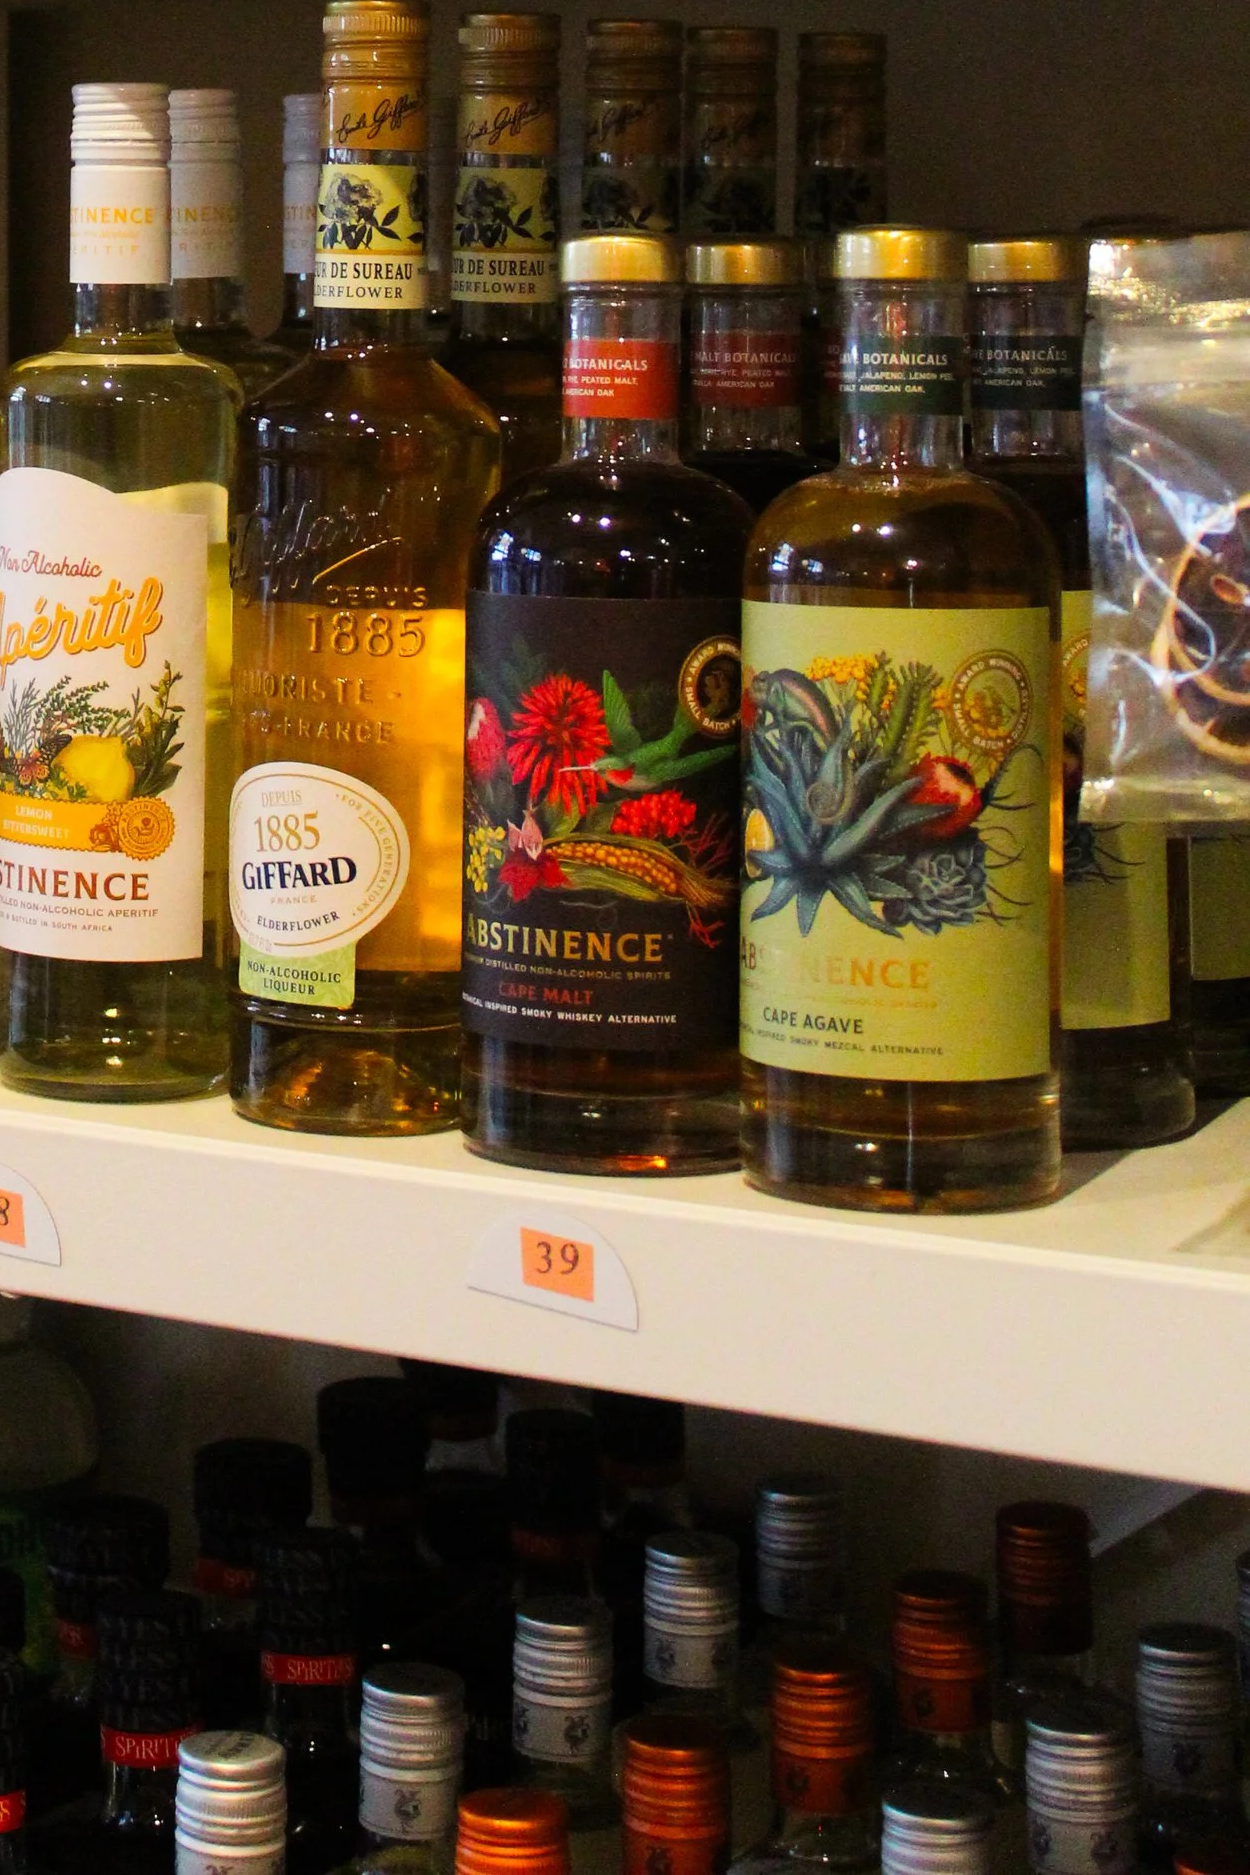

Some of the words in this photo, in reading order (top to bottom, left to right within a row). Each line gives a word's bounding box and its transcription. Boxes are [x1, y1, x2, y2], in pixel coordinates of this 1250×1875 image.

[331, 262, 348, 279] DE
[350, 262, 414, 280] SUREAU
[465, 259, 482, 276] DE
[485, 259, 545, 277] SUREAU
[863, 352, 948, 366] BOTANICALS
[987, 349, 1068, 361] BOTANICALS
[569, 358, 648, 371] BOTANICALS
[581, 376, 611, 385] PEATED
[909, 372, 938, 380] LEMON
[597, 389, 614, 397] OAK
[859, 384, 901, 393] AMERICAN
[21, 555, 102, 579] Alcoholic
[307, 611, 426, 658] 1885
[702, 717, 730, 731] BATCH
[261, 789, 302, 808] DEPUIS
[341, 794, 361, 812] FOR
[15, 803, 54, 821] LEMON
[3, 819, 70, 840] BITTERSWEET
[254, 811, 320, 853] 1885
[242, 856, 357, 890] GIFFARD
[270, 894, 317, 905] FRANCE
[20, 900, 104, 918] NON-ALCOHOLIC
[108, 906, 159, 918] APERITIF
[11, 913, 37, 926] BOTTLED
[41, 919, 49, 927] IN
[52, 920, 78, 931] SOUTH
[82, 922, 113, 932] AFRICA
[257, 911, 340, 932] ELDERFLOWER
[467, 913, 663, 962] ABSTINENCE
[247, 961, 341, 984] NON-ALCOHOLIC
[530, 965, 623, 980] NON-ALCOHOLIC
[627, 971, 671, 980] SPIRITS
[741, 936, 931, 991] ABENCE
[263, 978, 315, 995] LIQUEUR
[499, 981, 535, 1001] CAPE
[543, 988, 593, 1005] MALT
[485, 1001, 518, 1014] INSPIRED
[521, 1008, 552, 1019] SMOKY
[557, 1012, 602, 1023] WHISKEY
[607, 1014, 677, 1024] ALTERNATIVE
[763, 1007, 798, 1027] CAPE
[803, 1013, 864, 1035] AGAVE
[790, 1035, 820, 1047] SMOKY
[824, 1041, 865, 1053] MEZCAL
[871, 1045, 945, 1056] ALTERNATIVE
[534, 1240, 582, 1276] 39
